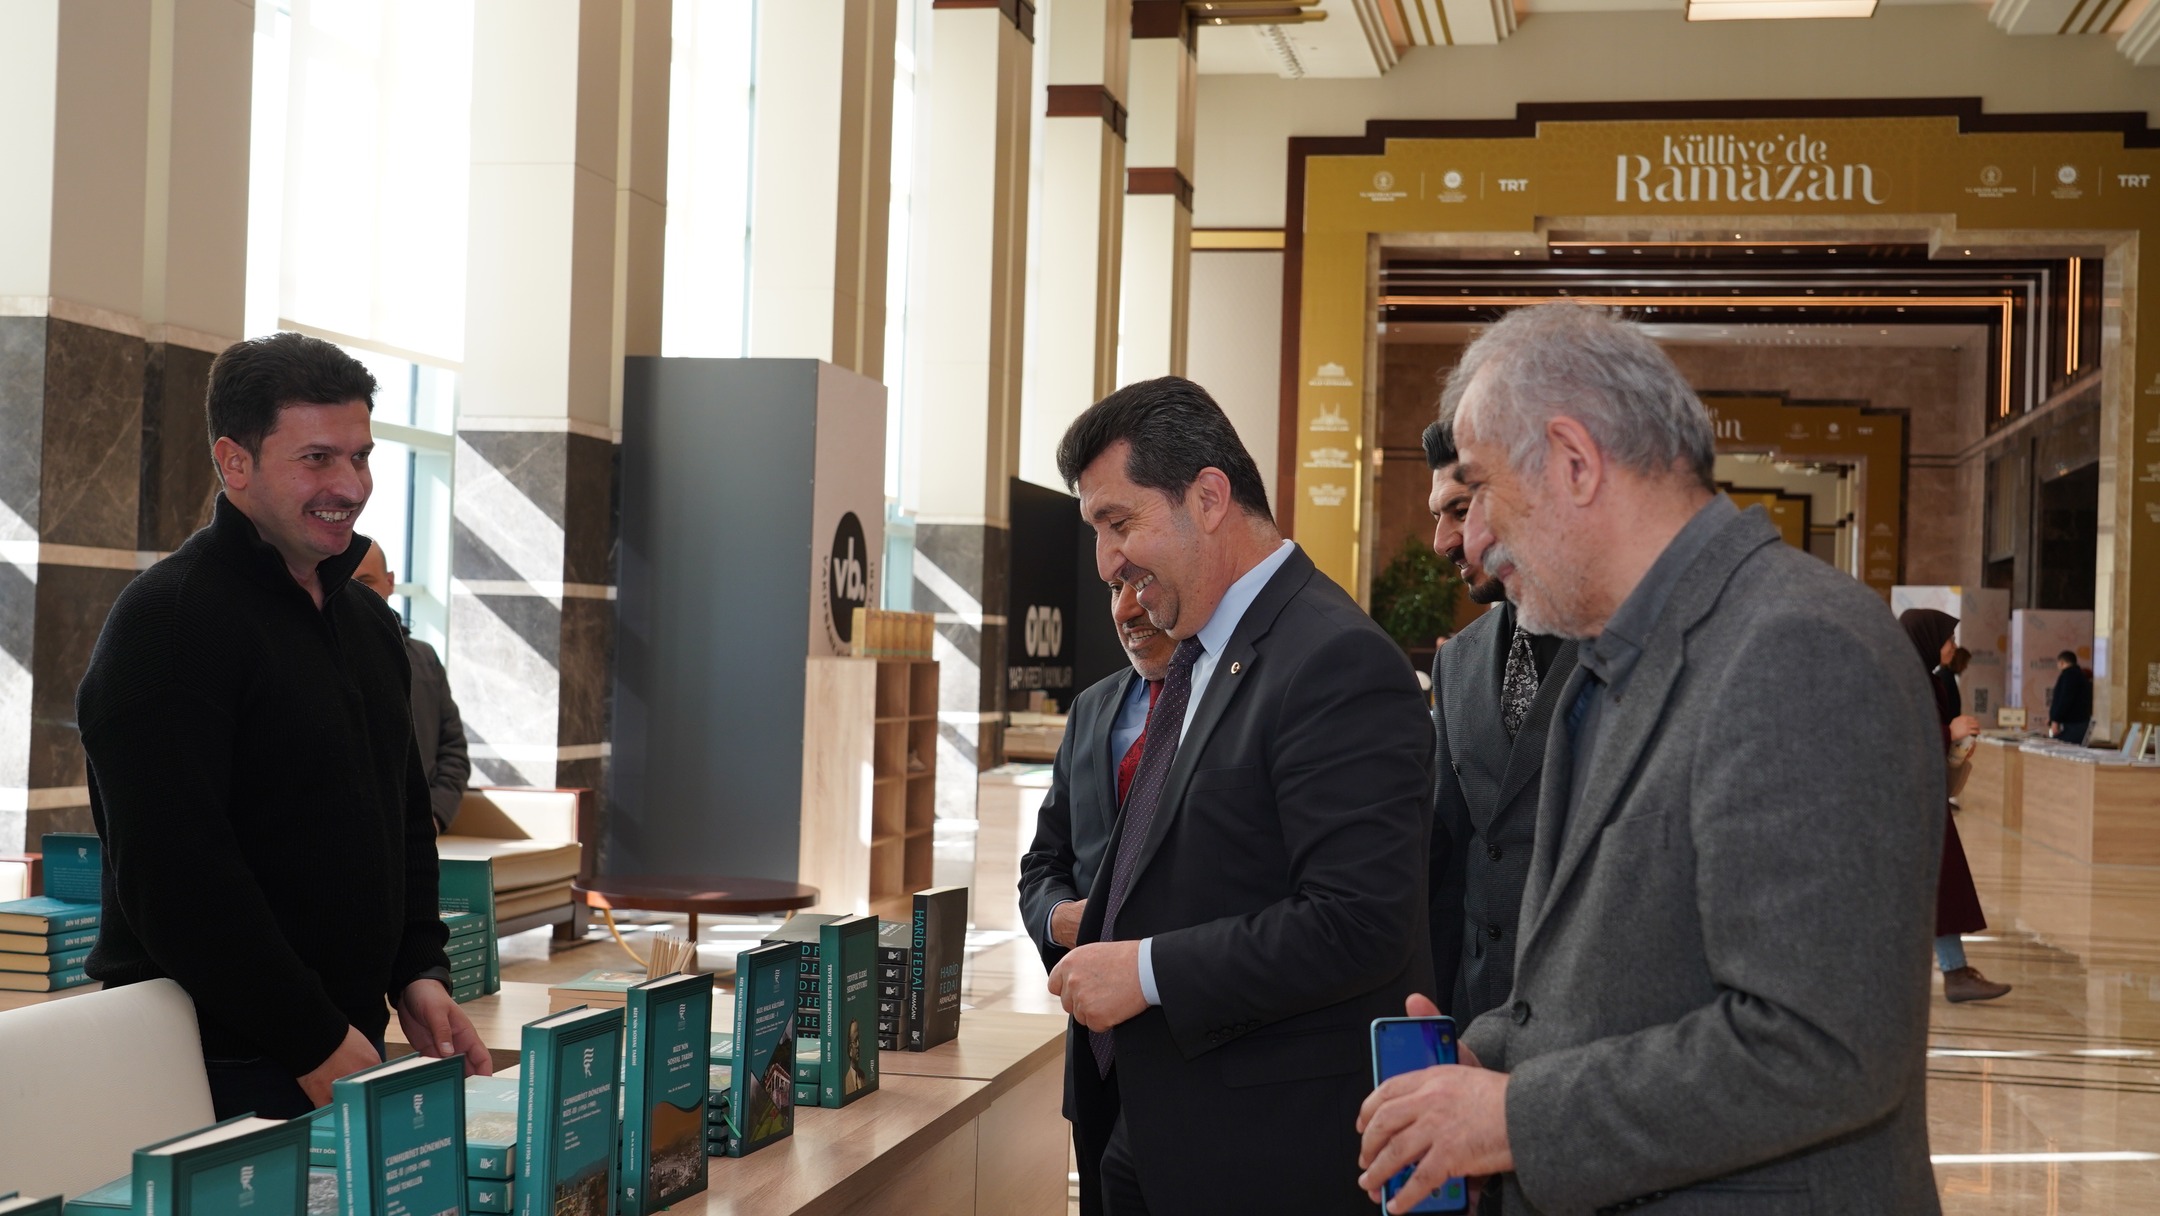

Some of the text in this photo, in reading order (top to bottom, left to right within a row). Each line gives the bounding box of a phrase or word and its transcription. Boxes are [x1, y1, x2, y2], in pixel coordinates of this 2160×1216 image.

[1497, 178, 1529, 192] TRT
[1616, 154, 1888, 205] Ramazan
[2117, 174, 2151, 188] TRT
[914, 910, 926, 948] HARİD
[912, 952, 924, 991] FEDAİ
